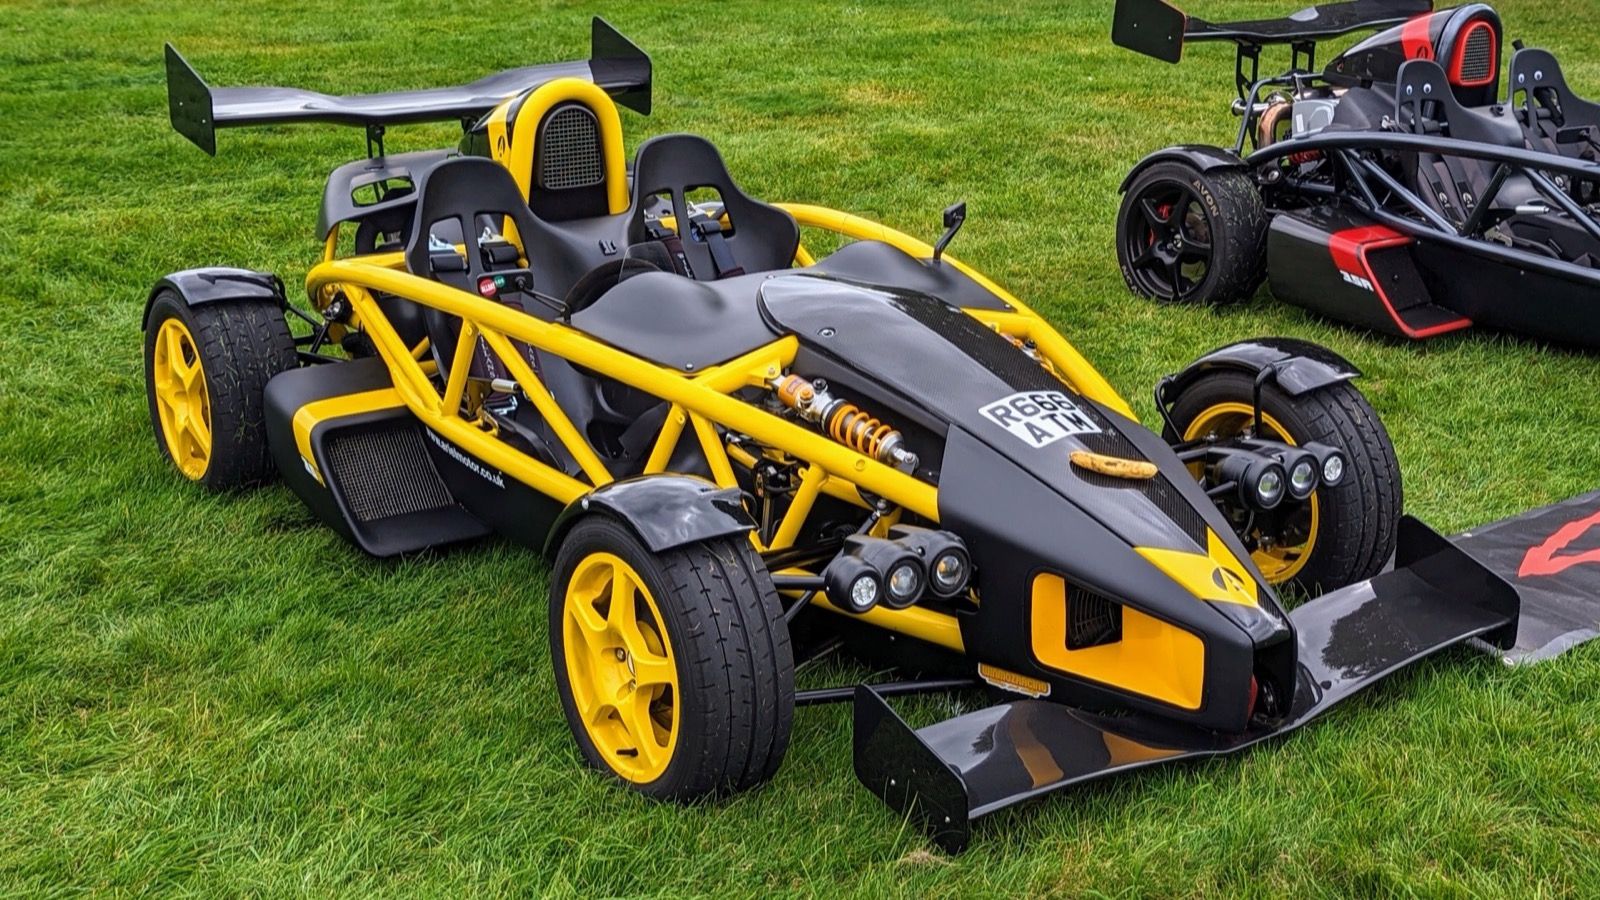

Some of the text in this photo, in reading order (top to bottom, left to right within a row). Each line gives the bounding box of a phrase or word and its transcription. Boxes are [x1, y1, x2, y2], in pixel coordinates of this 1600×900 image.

[1193, 180, 1219, 217] AVON
[987, 393, 1077, 428] R666
[1023, 412, 1095, 444] ATM
